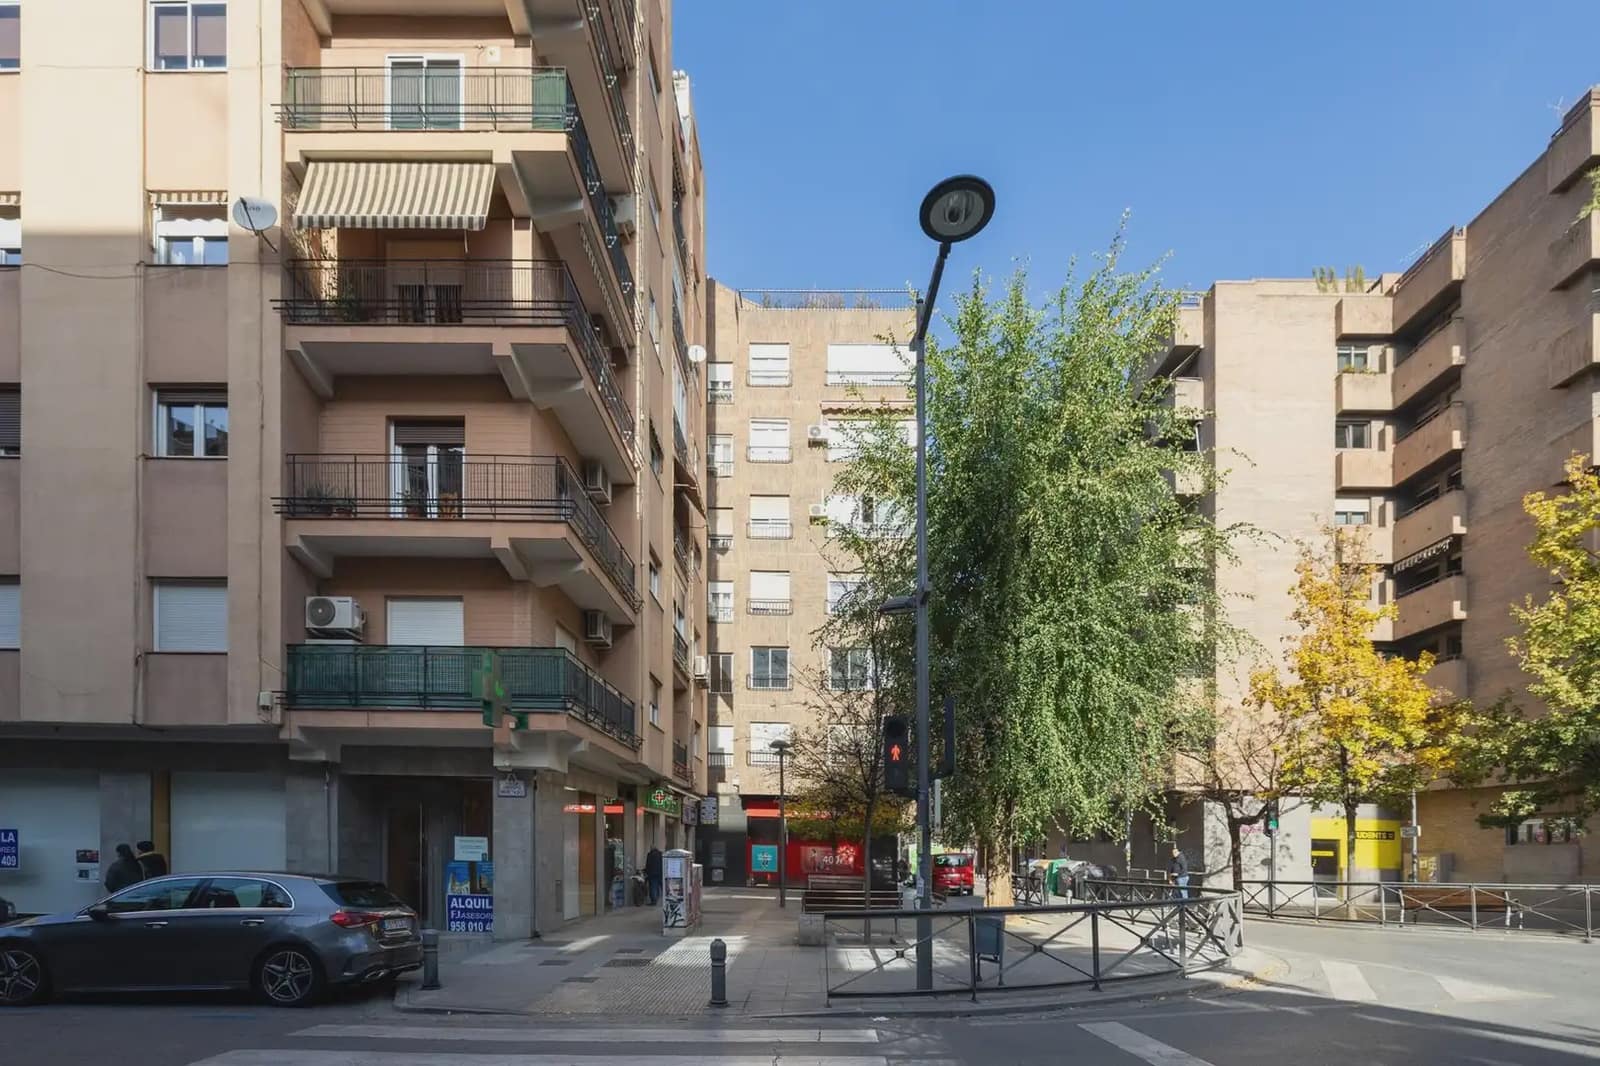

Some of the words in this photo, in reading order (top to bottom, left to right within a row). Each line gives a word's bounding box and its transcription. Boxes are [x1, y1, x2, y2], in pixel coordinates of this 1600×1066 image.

[451, 898, 493, 908] ALQUIL
[450, 921, 465, 931] 958
[467, 921, 484, 931] 010
